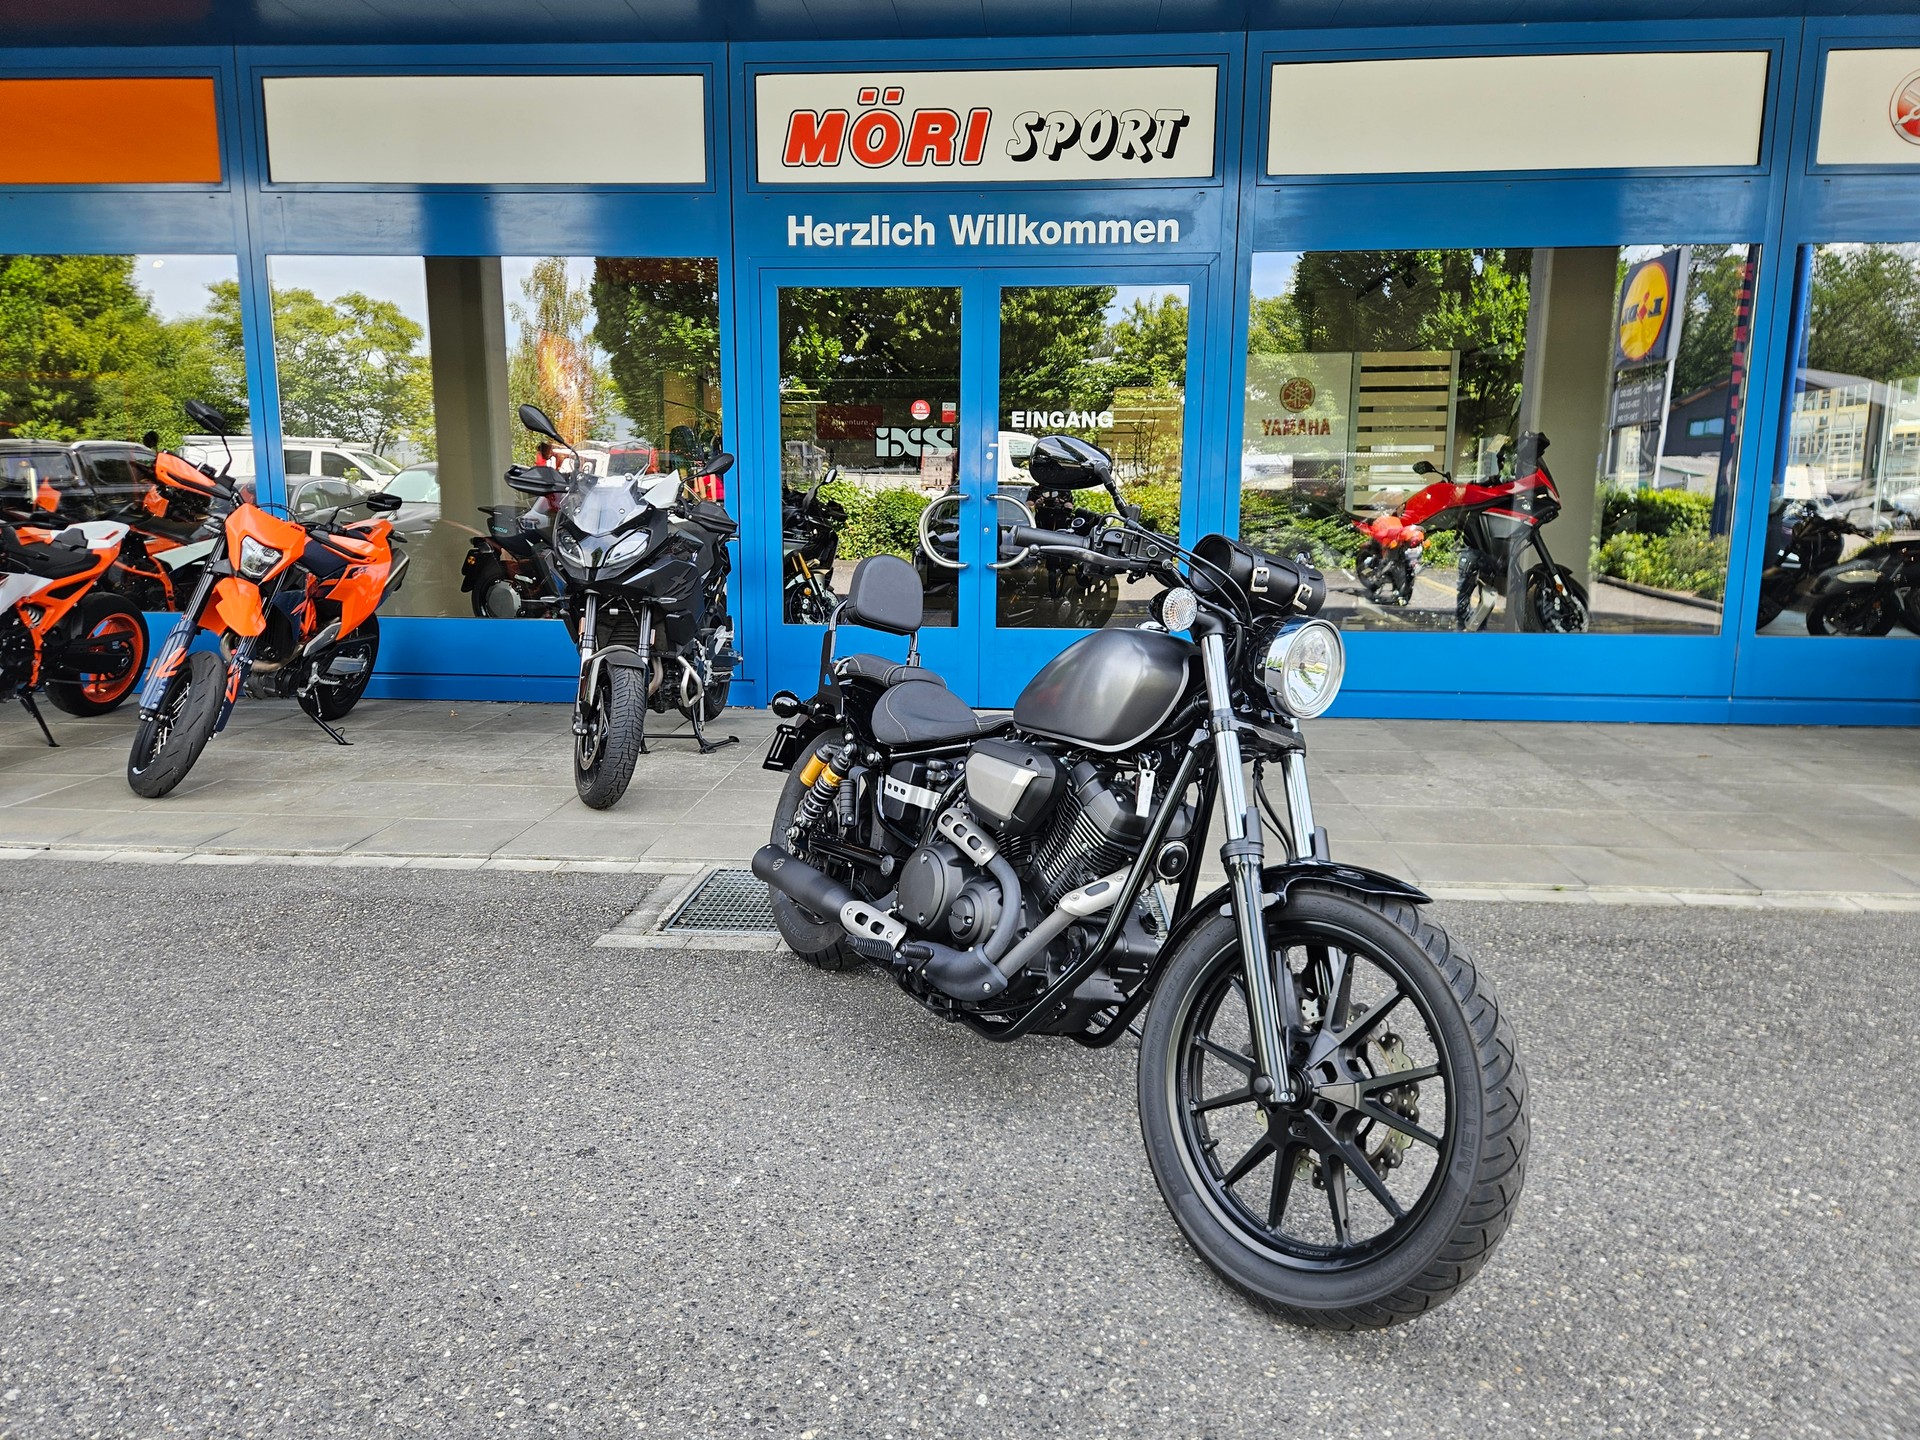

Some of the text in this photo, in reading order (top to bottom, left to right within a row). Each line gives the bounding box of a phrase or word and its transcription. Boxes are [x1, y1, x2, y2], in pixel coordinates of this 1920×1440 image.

[782, 86, 1190, 168] MÖRI SPORT
[787, 213, 1180, 247] Herzlich Willkommen
[1011, 410, 1114, 428] EINGANG
[1261, 418, 1332, 436] YAMAHA
[1448, 1020, 1477, 1175] METZELER
[1154, 1135, 1180, 1194] ULTRA
